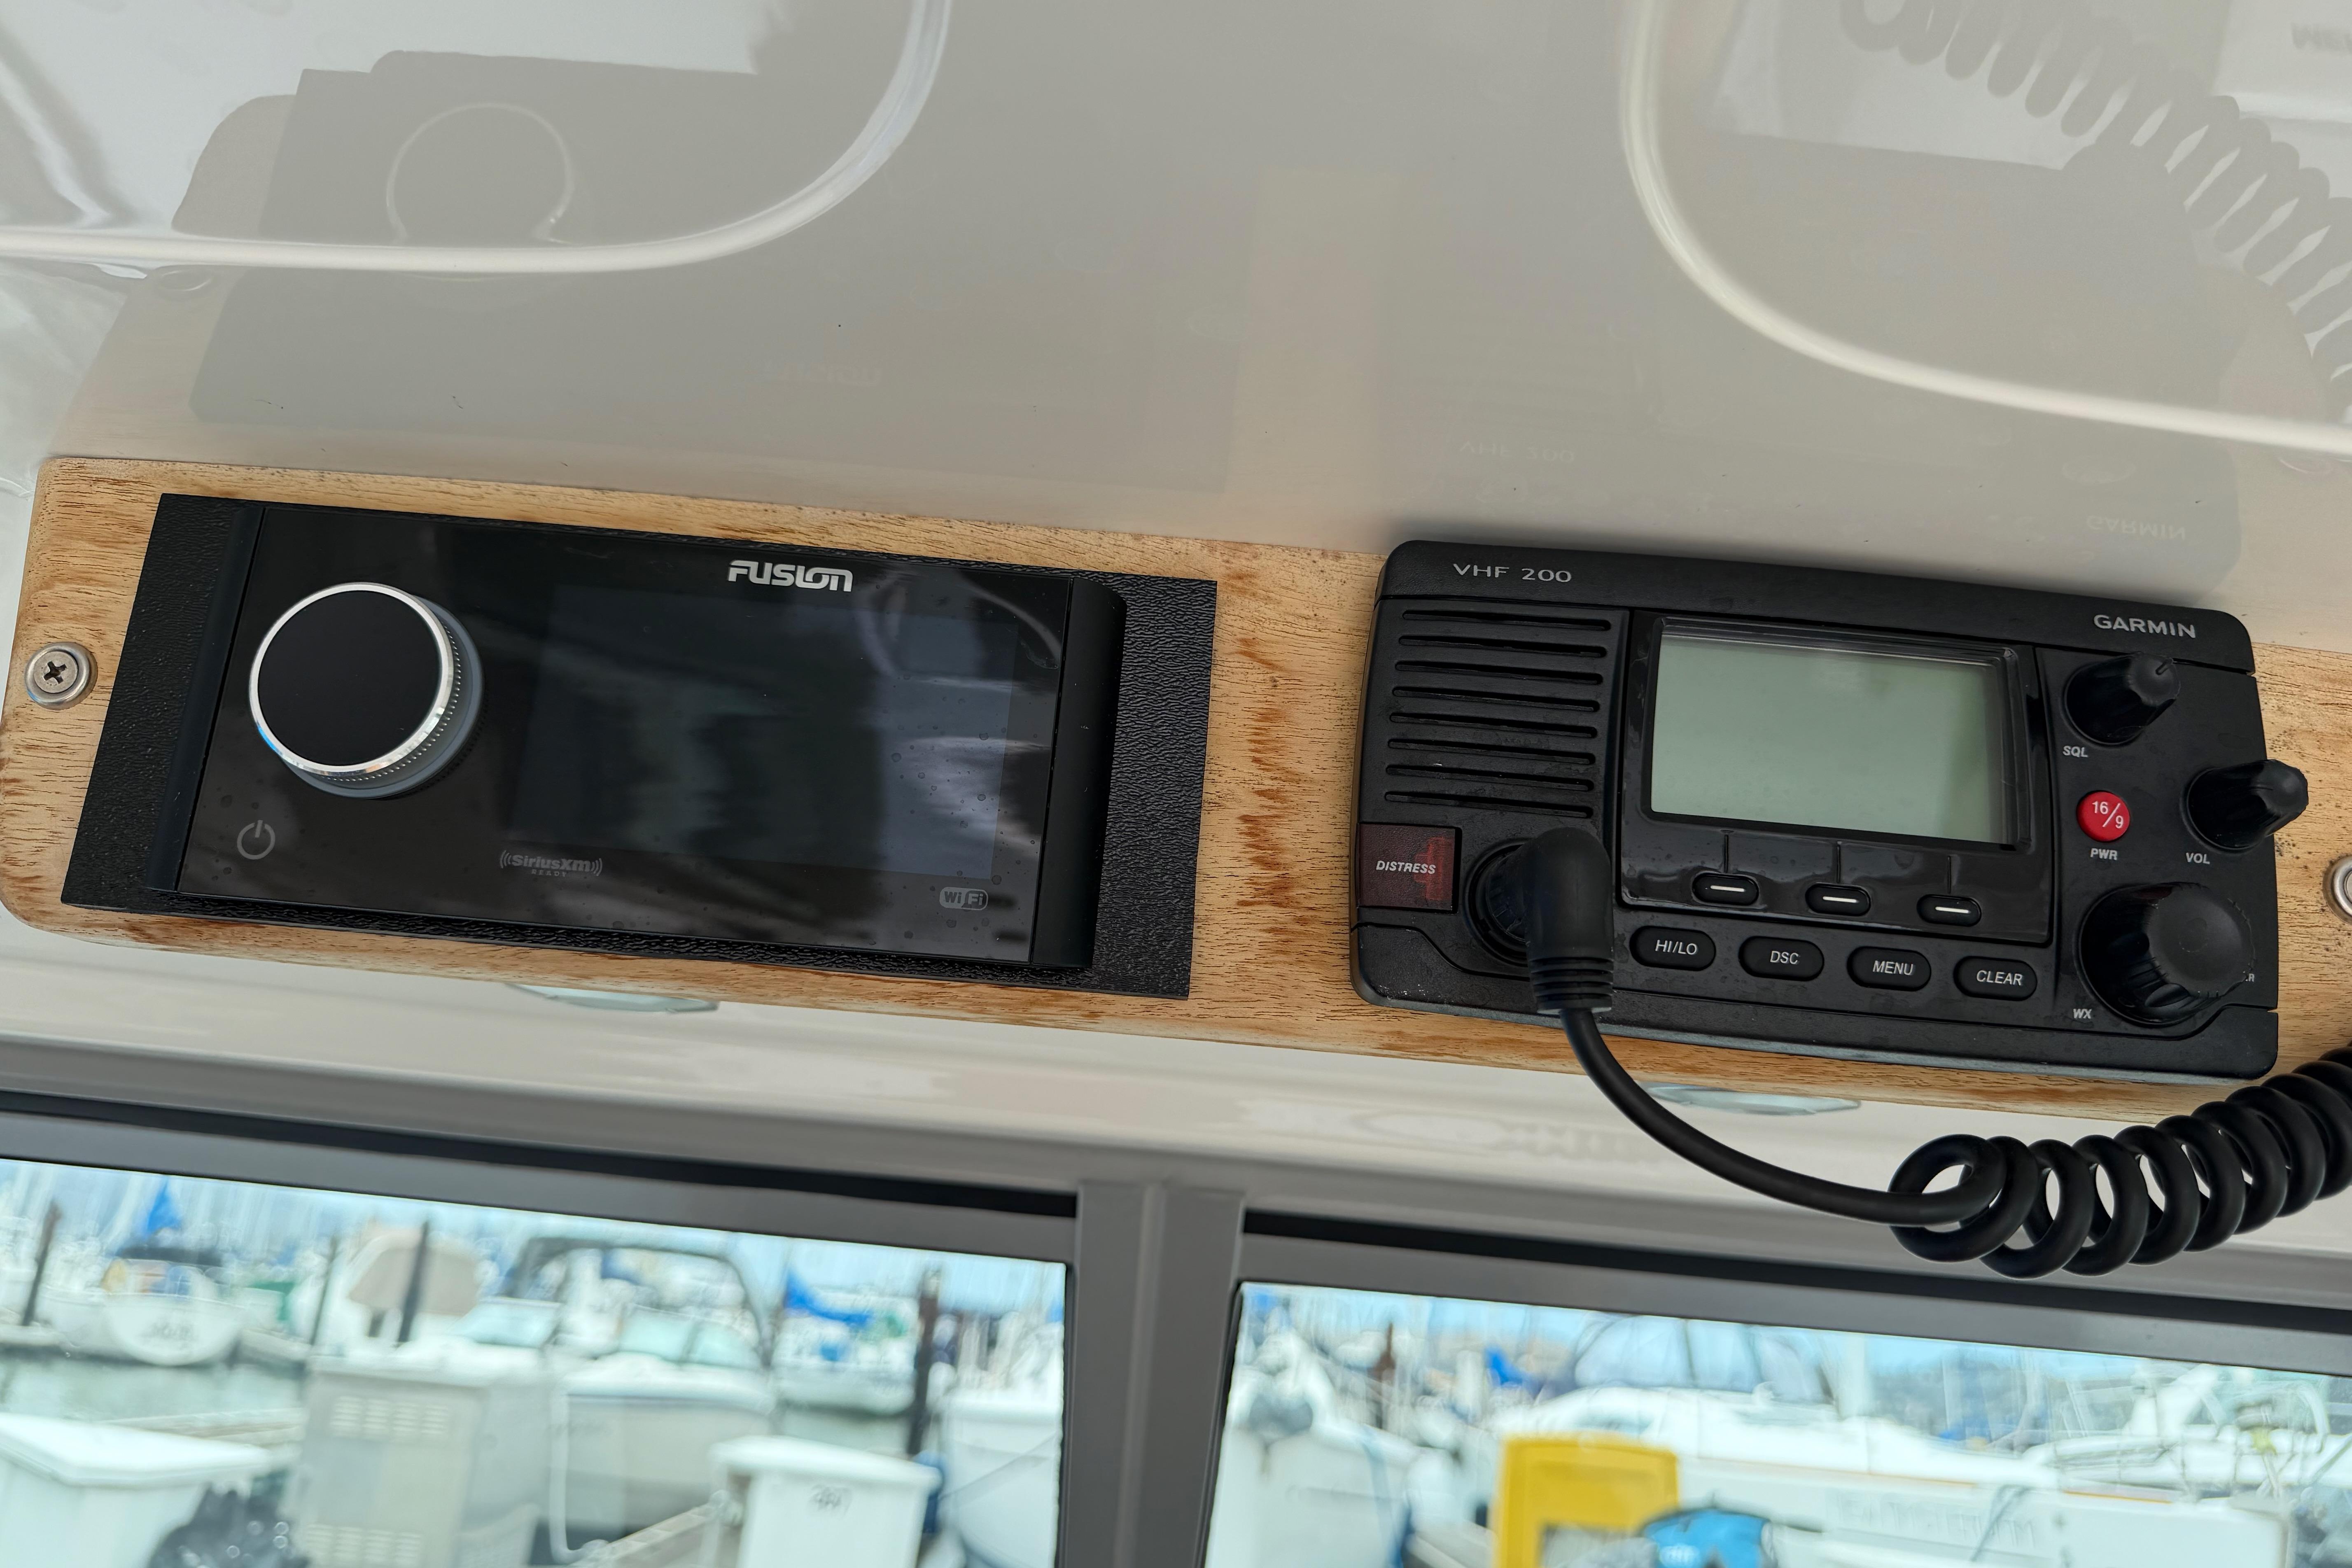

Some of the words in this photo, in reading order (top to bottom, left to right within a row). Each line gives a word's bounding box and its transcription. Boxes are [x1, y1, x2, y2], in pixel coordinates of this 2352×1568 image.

[728, 560, 853, 592] FUSION
[1453, 563, 1510, 578] VHF
[1521, 568, 1572, 583] 200
[2093, 614, 2196, 639] GARMIN
[2063, 745, 2088, 758] SQL
[2092, 801, 2124, 829] 16/9
[2090, 848, 2118, 861] PWR
[2186, 852, 2210, 865] VOL
[531, 869, 567, 877] READY
[1376, 860, 1437, 875] DISTRESS
[1654, 939, 1698, 955] HI/LO
[1769, 950, 1799, 965] DSC
[1872, 960, 1914, 976] MENU
[1976, 970, 2023, 986] CLEAR
[2073, 1008, 2092, 1020] WX
